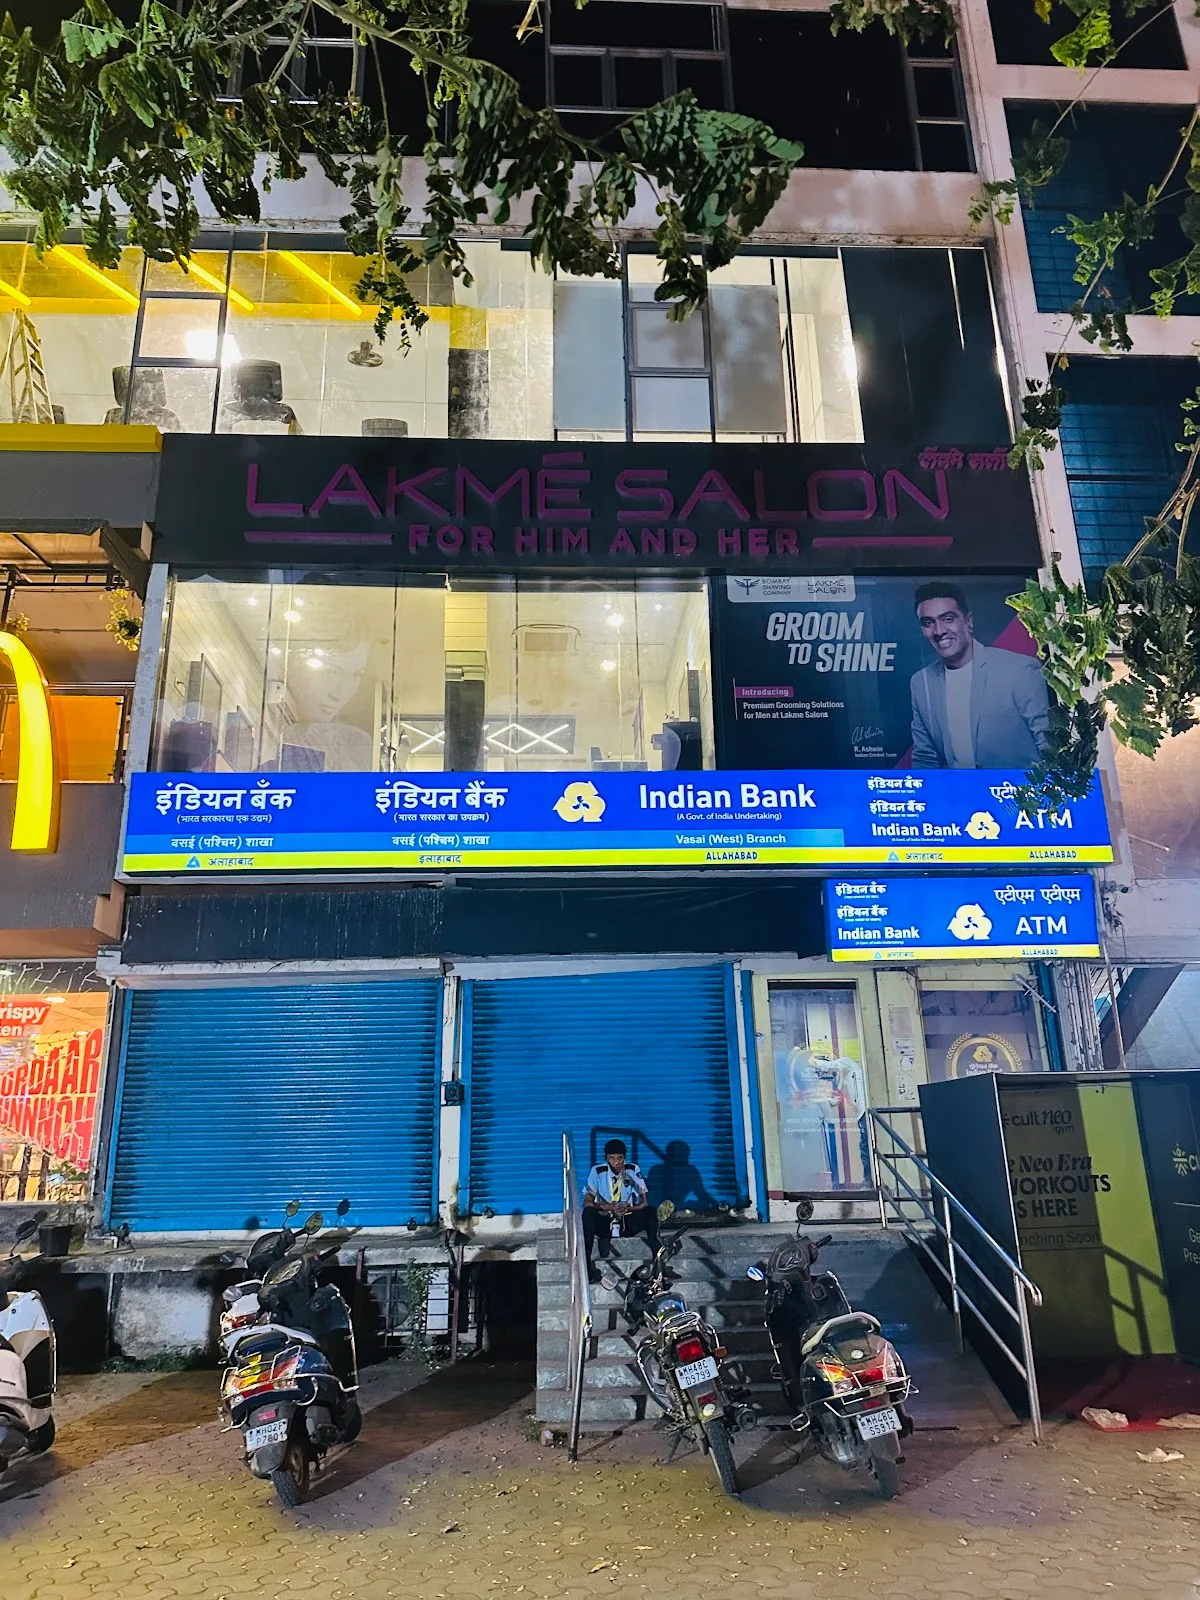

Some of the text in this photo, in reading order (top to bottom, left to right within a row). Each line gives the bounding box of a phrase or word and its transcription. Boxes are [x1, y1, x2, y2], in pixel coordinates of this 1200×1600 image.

[245, 452, 950, 521] LAKMÉ SALON
[408, 524, 800, 556] FOR HIM AND HER
[766, 612, 865, 641] GROOM
[787, 643, 897, 673] TO SHINE
[742, 688, 789, 697] Introducing
[776, 702, 810, 711] Grooming
[811, 701, 844, 709] Solutions
[805, 711, 828, 719] Salons
[867, 776, 903, 790] इंडियन
[156, 778, 296, 814] इंडियन बँक
[375, 779, 508, 814] इंडियन बैंक
[640, 783, 816, 809] Indian Bank
[869, 800, 906, 814] इंडियन
[236, 815, 250, 823] एक
[420, 814, 446, 822] सरकार
[448, 814, 458, 822] का
[677, 812, 782, 822] (A Govt. of India Undertaking)
[1015, 808, 1073, 829] ATM
[872, 822, 962, 836] Indian Bank
[171, 835, 274, 850] वसई (पश्चिम) शाखा
[392, 833, 490, 848] वसई (पश्चिम) शाखा
[676, 833, 786, 846] Vasai (West) Branch
[419, 854, 463, 864] इलाहाबाद
[706, 851, 758, 861] ALLAHABAD
[1029, 850, 1077, 859] ALLAHABAD
[208, 857, 254, 867] अलाहाबाद
[835, 883, 868, 896] इंडियन
[993, 884, 1081, 905] एटीएम एटीएम
[836, 905, 870, 919] इंडियन
[1016, 916, 1067, 935] ATM
[838, 926, 920, 940] Indian Bank
[0, 1025, 22, 1037] en
[1012, 1110, 1072, 1126] cult neo
[1055, 1126, 1073, 1135] gym
[1020, 1155, 1053, 1172] Neo
[1057, 1154, 1092, 1171] Era
[1032, 1198, 1078, 1217] HERE
[1067, 1230, 1100, 1243] Soon
[683, 1360, 707, 1376] MH48C
[685, 1369, 711, 1386] D9799
